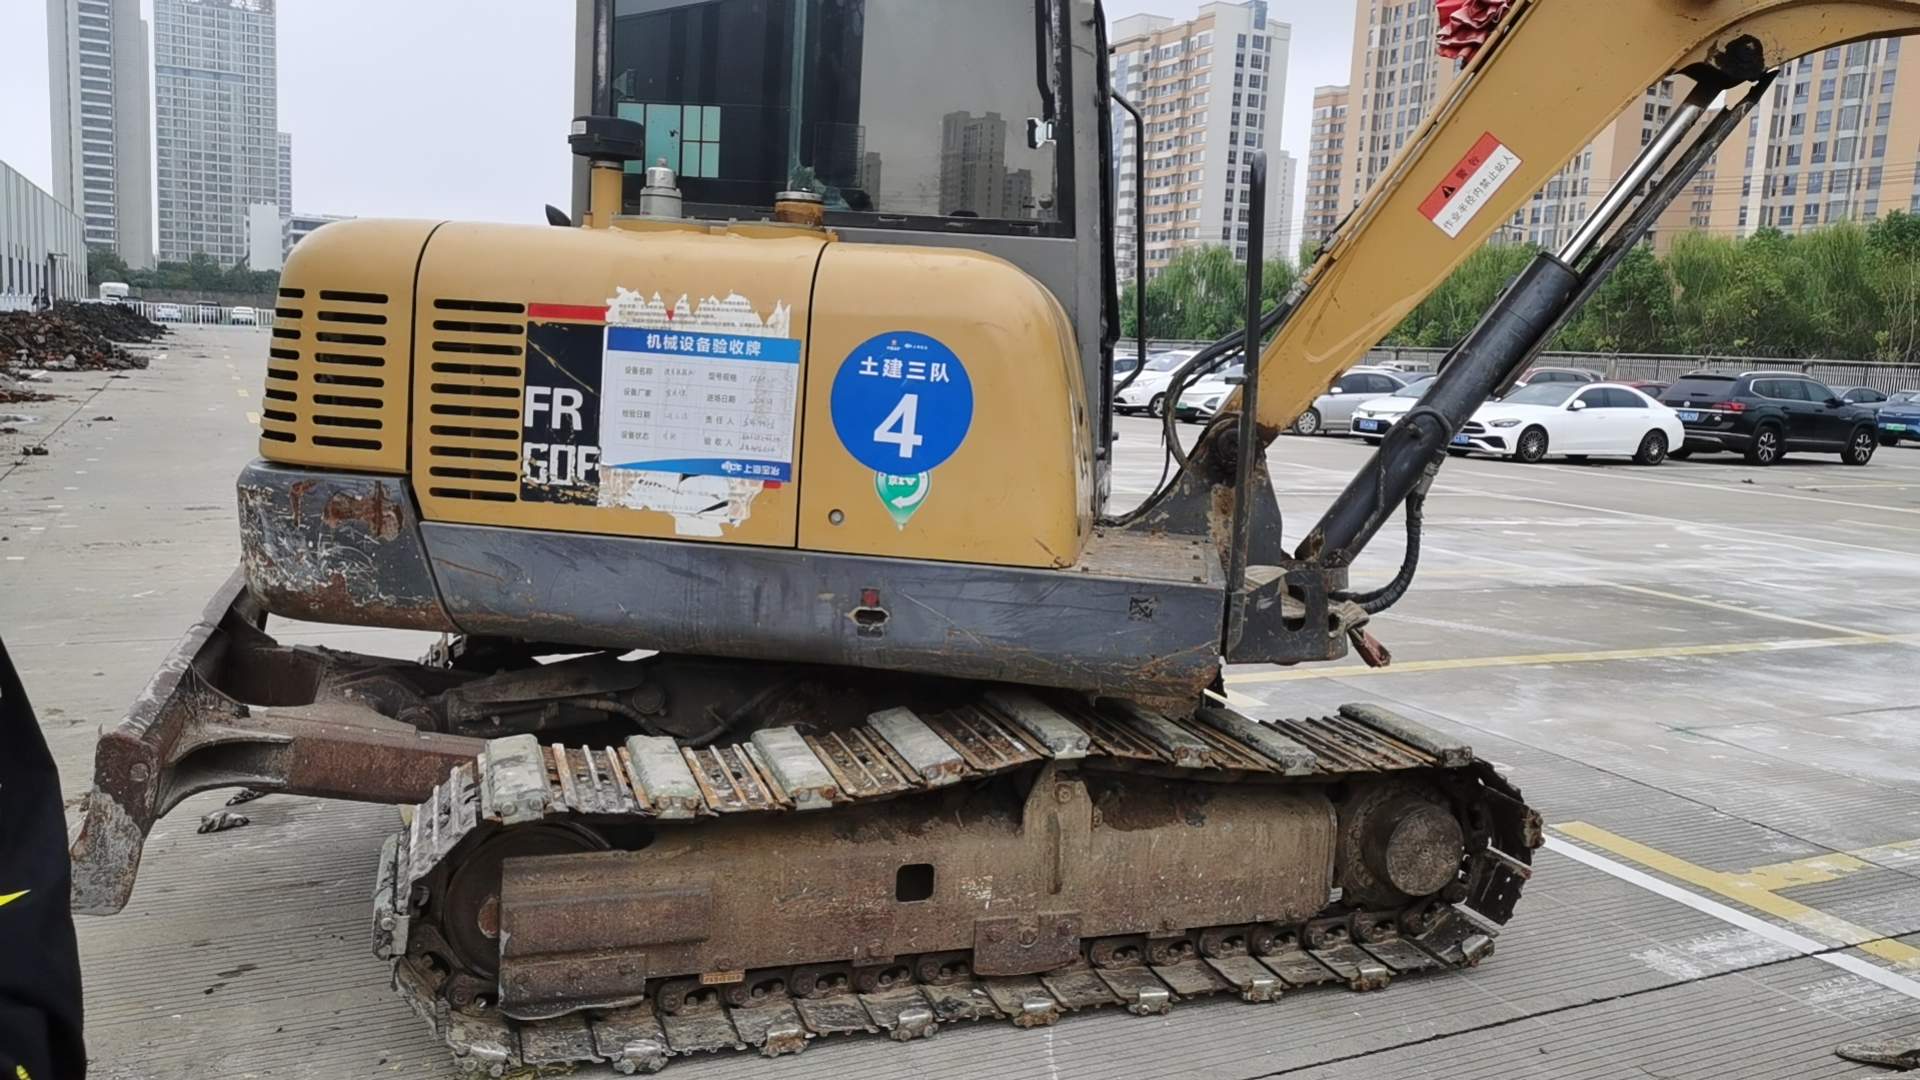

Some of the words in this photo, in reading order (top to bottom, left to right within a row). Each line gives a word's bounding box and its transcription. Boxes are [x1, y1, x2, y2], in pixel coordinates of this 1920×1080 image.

[1443, 154, 1513, 230] 作业半径内禁止站人
[646, 333, 761, 356] 机械设备验收牌
[859, 356, 950, 383] 土建三队
[524, 385, 584, 431] FR
[873, 393, 923, 458] 4
